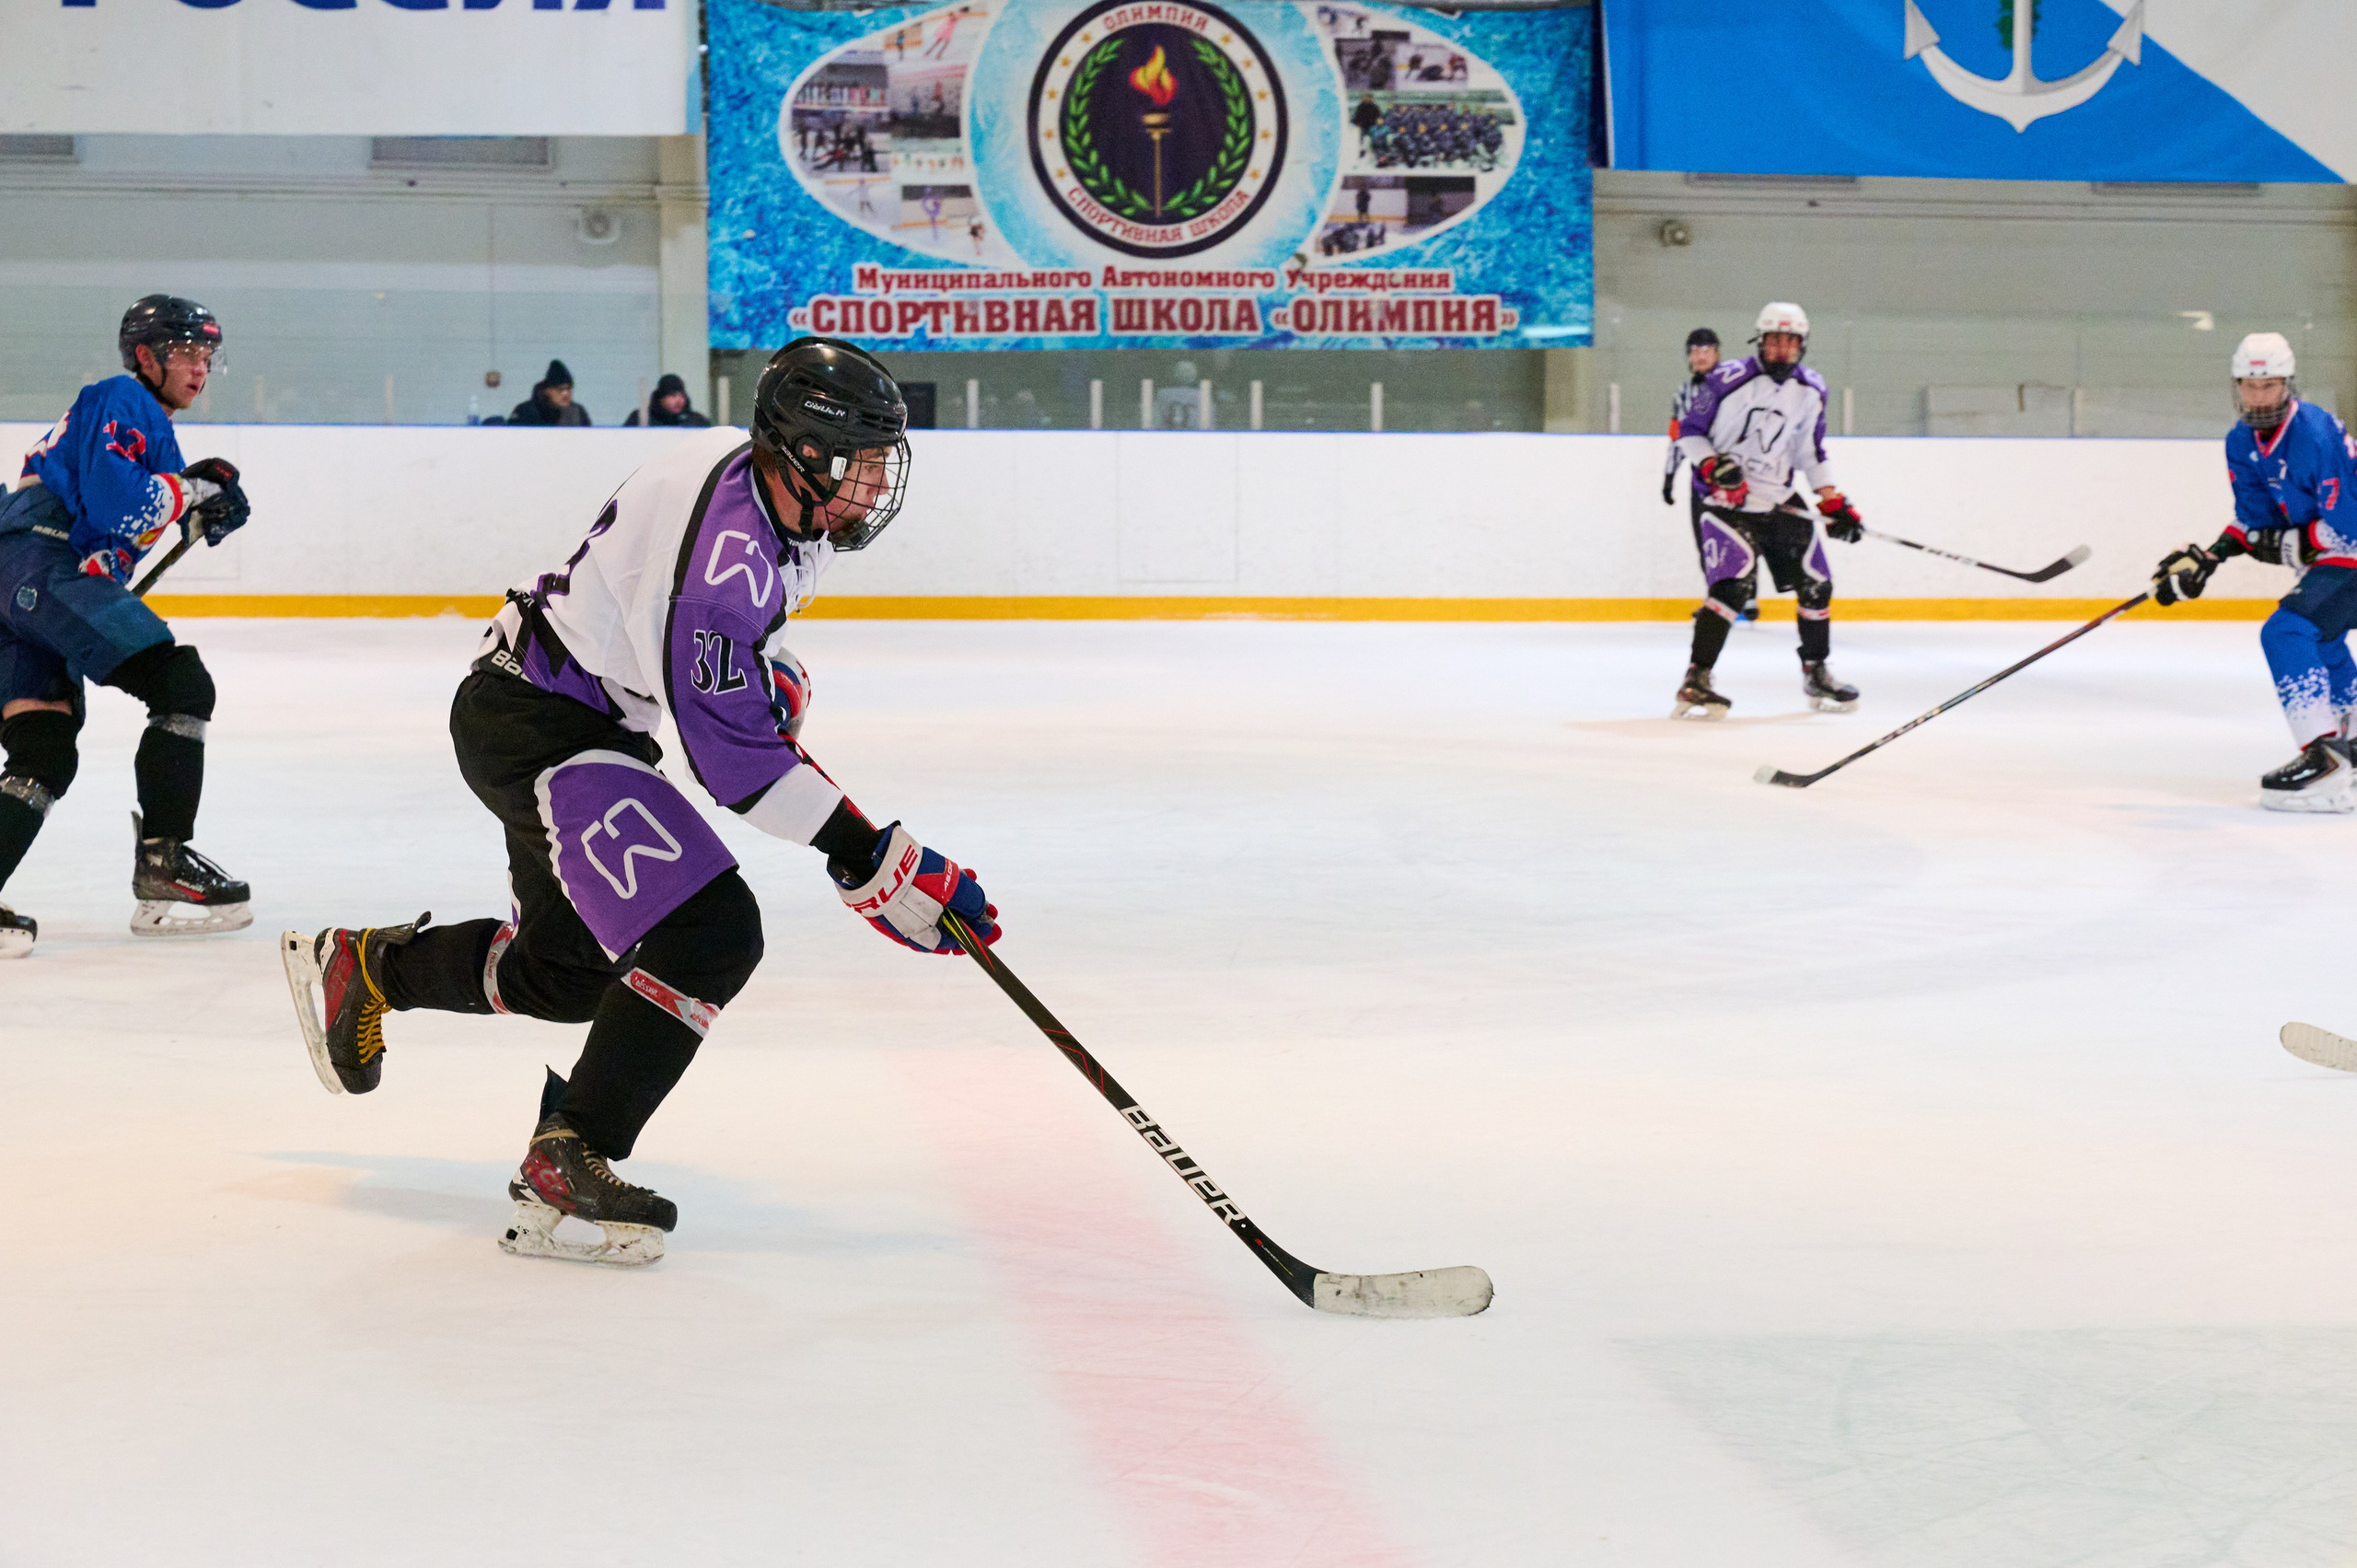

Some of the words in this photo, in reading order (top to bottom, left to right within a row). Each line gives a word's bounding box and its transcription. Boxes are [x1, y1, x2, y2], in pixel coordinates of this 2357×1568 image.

[1102, 5, 1209, 31] ОЛИМПИЯ
[1067, 187, 1183, 243] СПОРТИВНАЯ
[1190, 189, 1250, 237] ШКОЛА
[857, 267, 1092, 292] Муниципального
[1102, 265, 1275, 287] Автономного
[1285, 269, 1450, 293] Учреждения
[1112, 299, 1259, 332] ШКОЛА
[1274, 298, 1515, 333] «ОЛИМПИЯ»
[691, 629, 748, 695] 32
